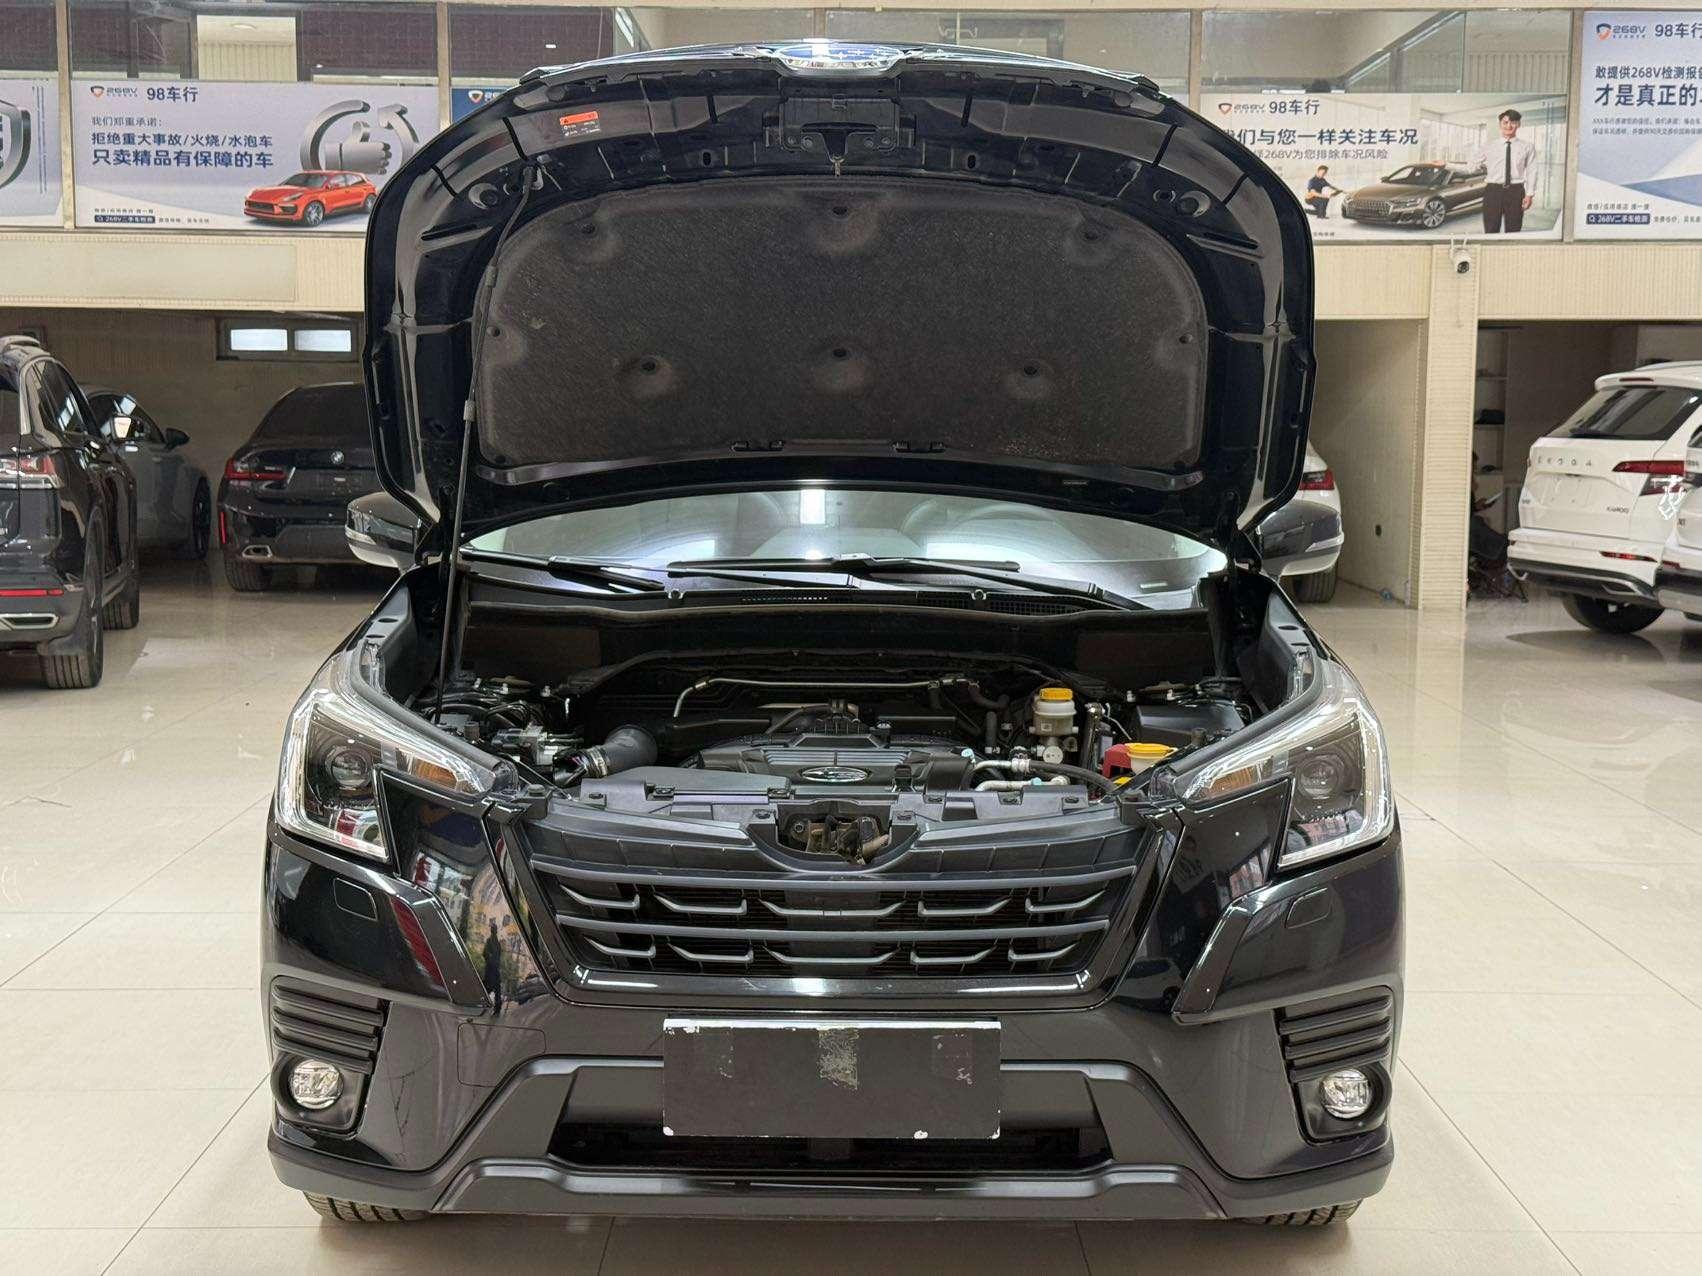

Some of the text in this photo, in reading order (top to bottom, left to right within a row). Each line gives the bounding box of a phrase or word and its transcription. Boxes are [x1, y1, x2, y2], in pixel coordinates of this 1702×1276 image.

[1655, 22, 1702, 39] 98车行
[146, 86, 199, 103] 98车行
[1594, 83, 1702, 107] 才是真正的
[1268, 99, 1320, 115] 98车行
[91, 132, 273, 148] 拒绝重大事故/火烧/水泡车
[91, 149, 274, 169] 只卖精品有保障的车
